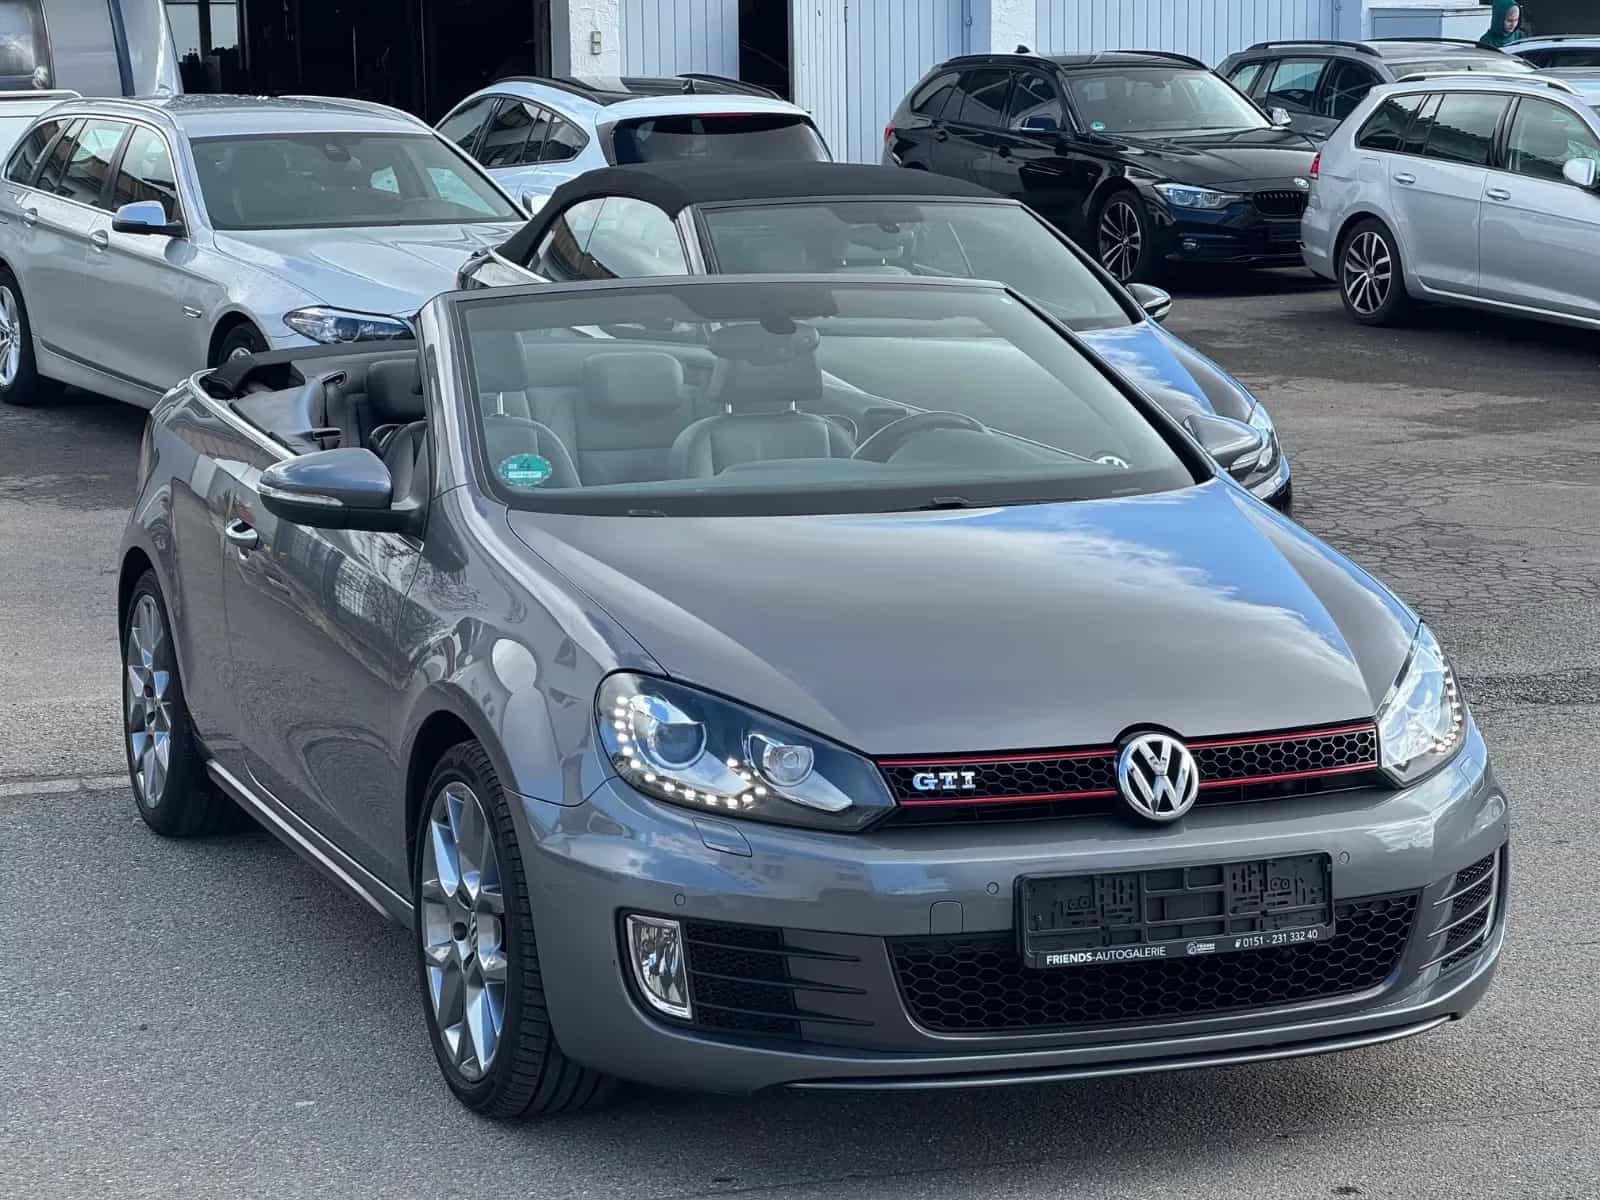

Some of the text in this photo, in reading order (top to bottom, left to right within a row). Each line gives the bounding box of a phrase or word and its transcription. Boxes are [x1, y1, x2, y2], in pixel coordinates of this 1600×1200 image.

[912, 771, 977, 791] GTI
[1118, 733, 1200, 820] VW
[1242, 935, 1264, 948] 0151
[1271, 932, 1287, 944] 231
[1289, 930, 1306, 942] 332
[1306, 929, 1319, 939] 40
[1046, 946, 1167, 965] FRIENDS-AUTOGALERIE
